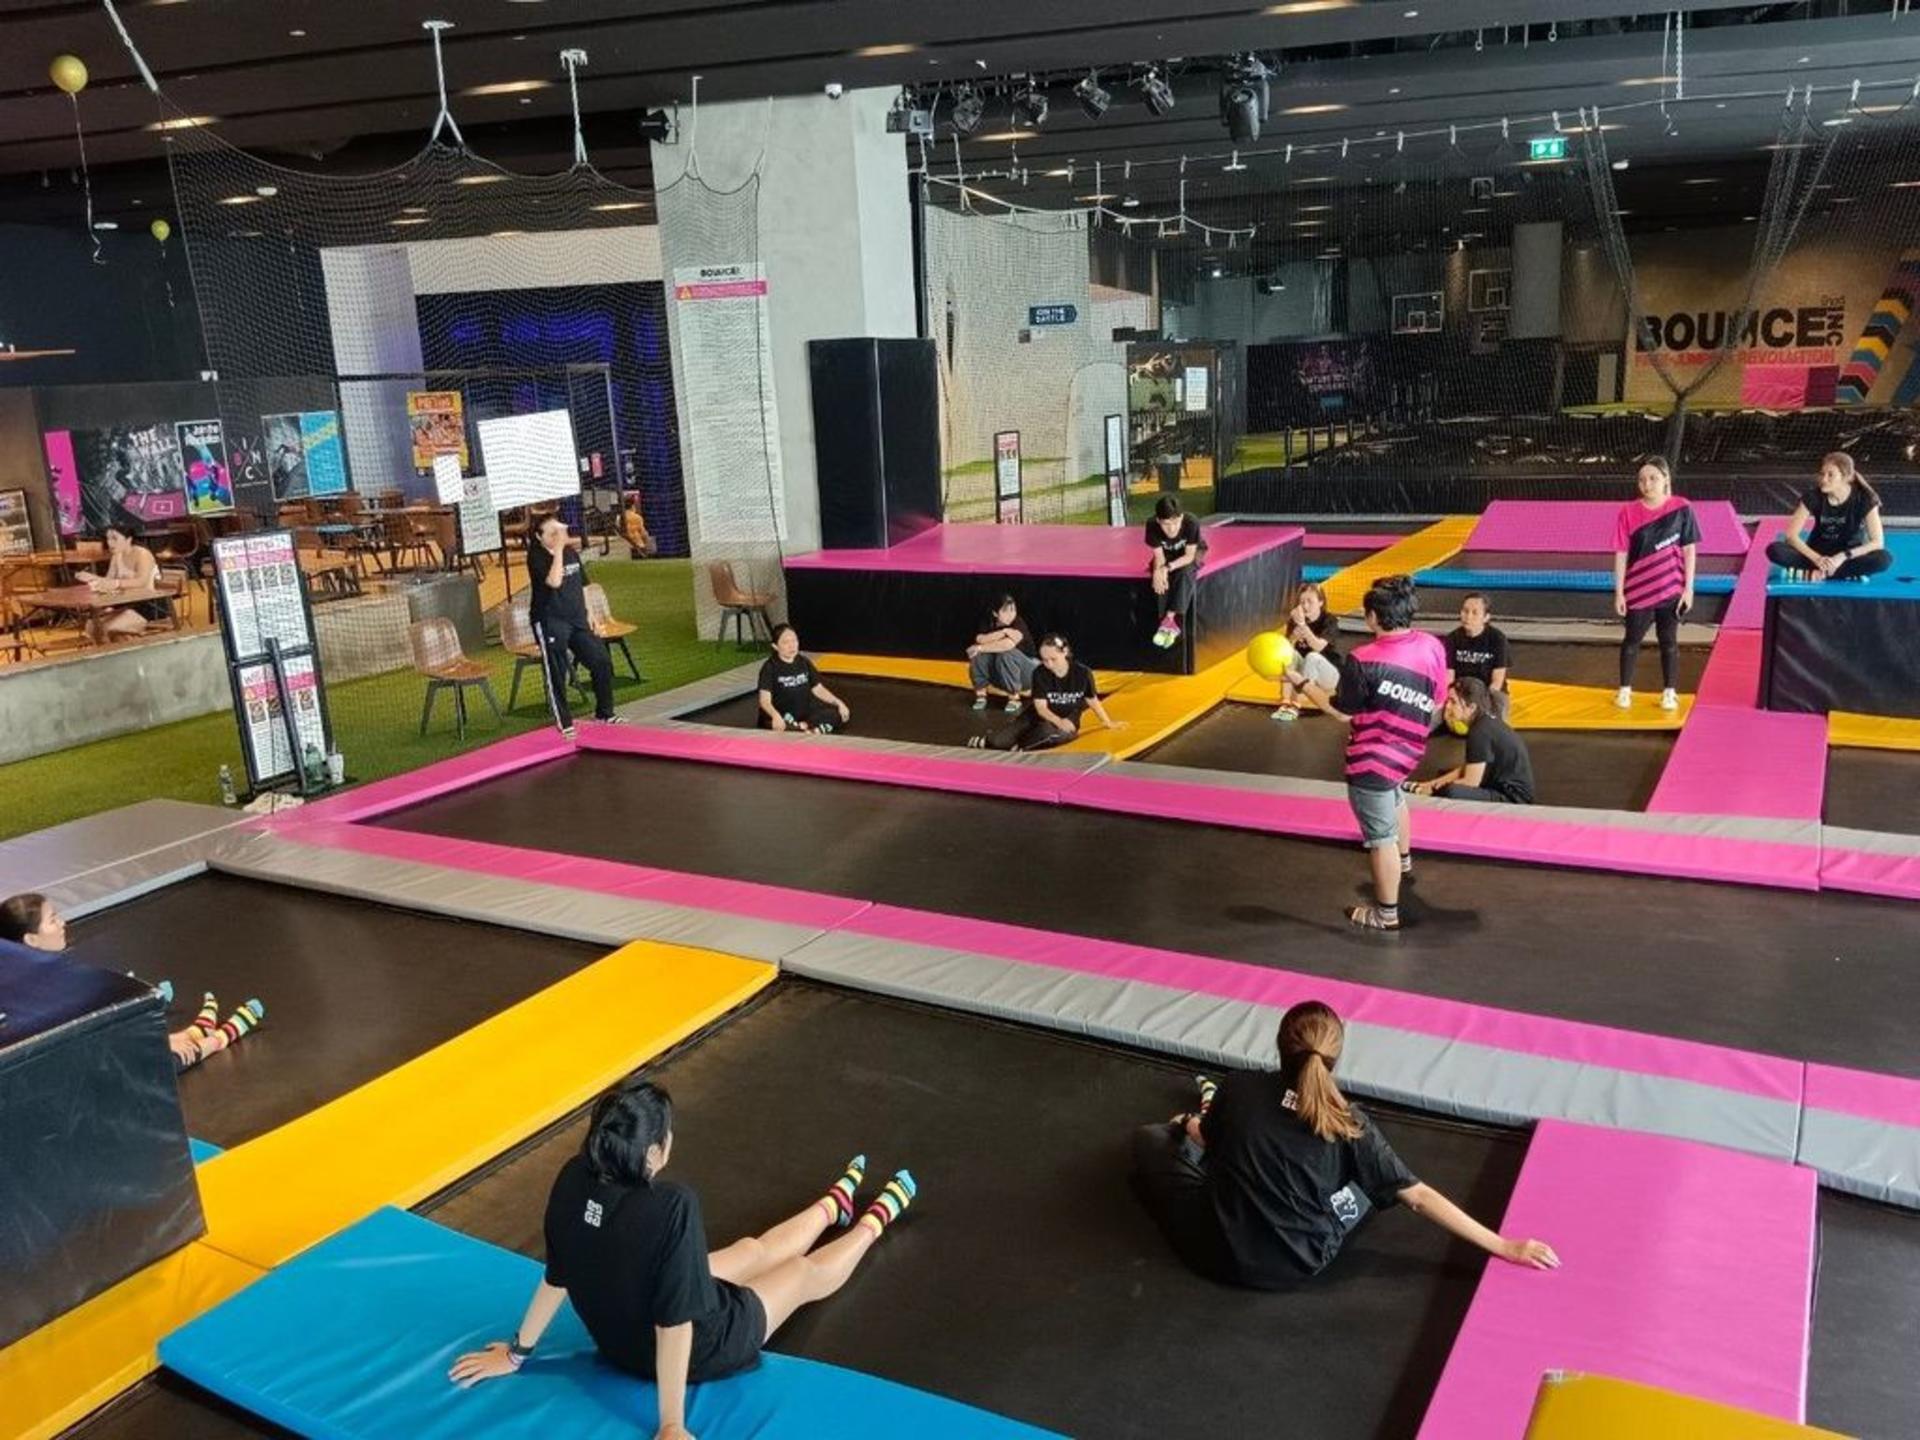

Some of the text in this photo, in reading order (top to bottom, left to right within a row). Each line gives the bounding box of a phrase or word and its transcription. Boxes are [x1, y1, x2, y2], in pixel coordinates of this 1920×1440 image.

[1636, 306, 1828, 352] BOUNCE
[1827, 305, 1845, 346] INC
[128, 428, 158, 448] THE
